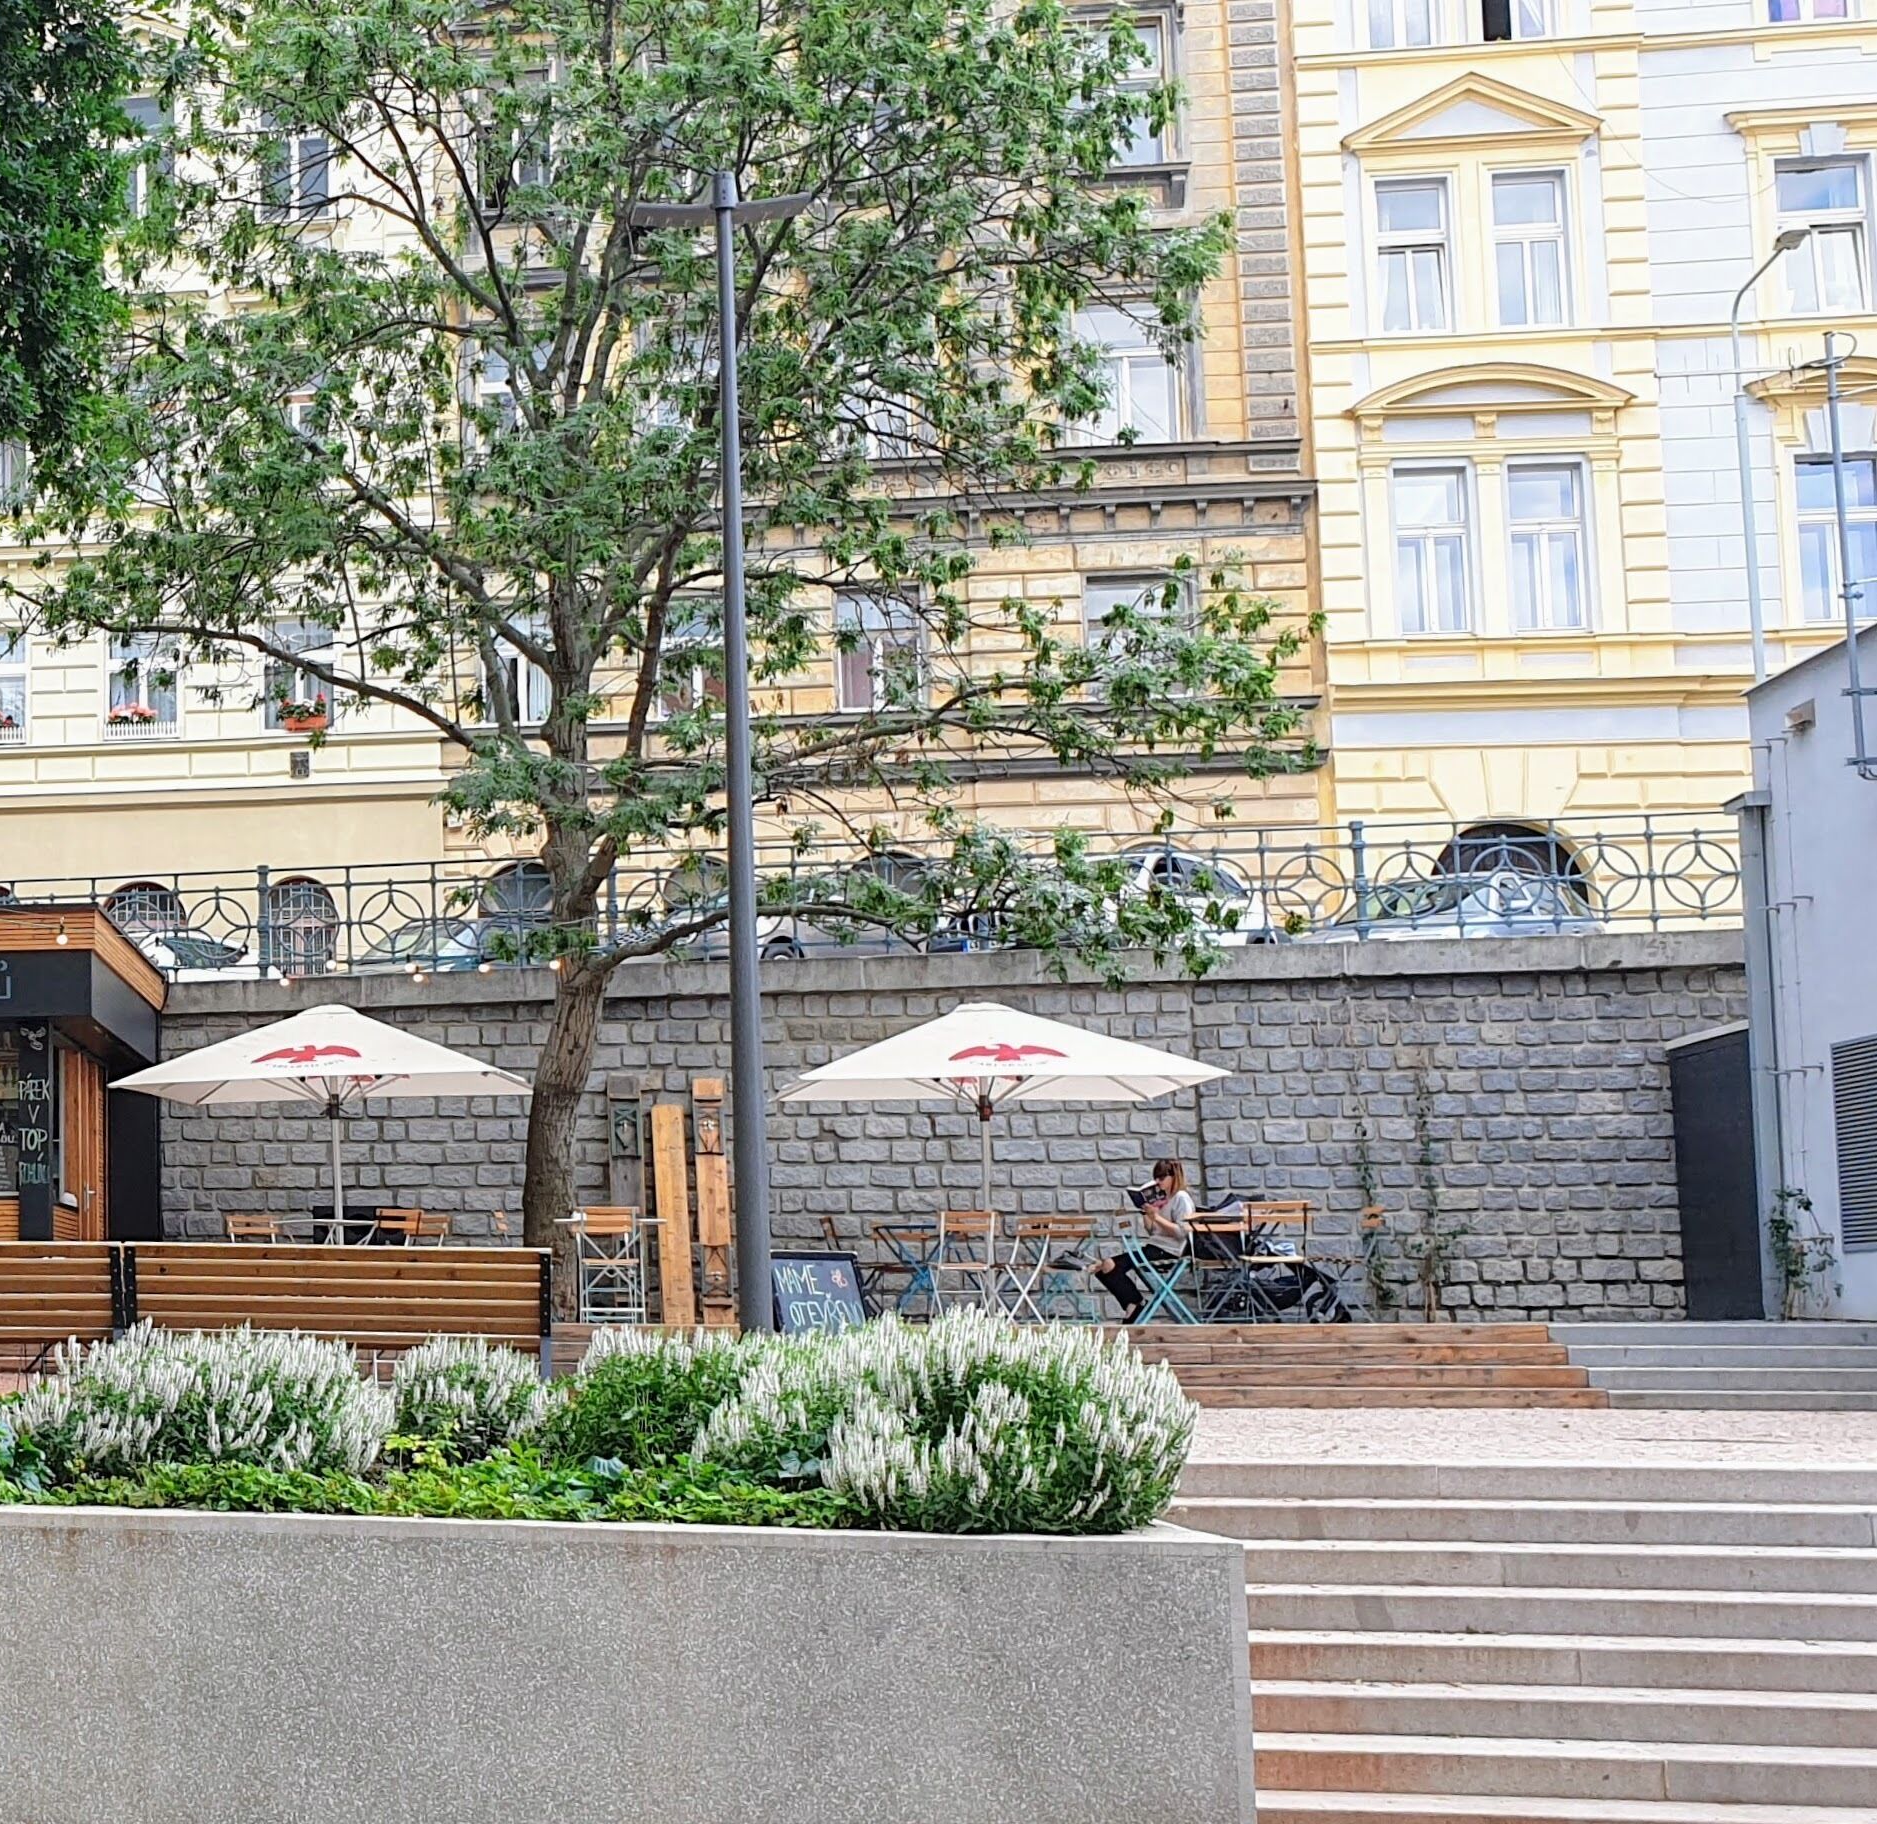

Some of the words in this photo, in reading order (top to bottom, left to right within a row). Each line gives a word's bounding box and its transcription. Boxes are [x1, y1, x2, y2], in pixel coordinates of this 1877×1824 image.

[28, 1103, 40, 1124] V
[18, 1127, 48, 1151] TOP
[774, 1262, 825, 1295] MÁME
